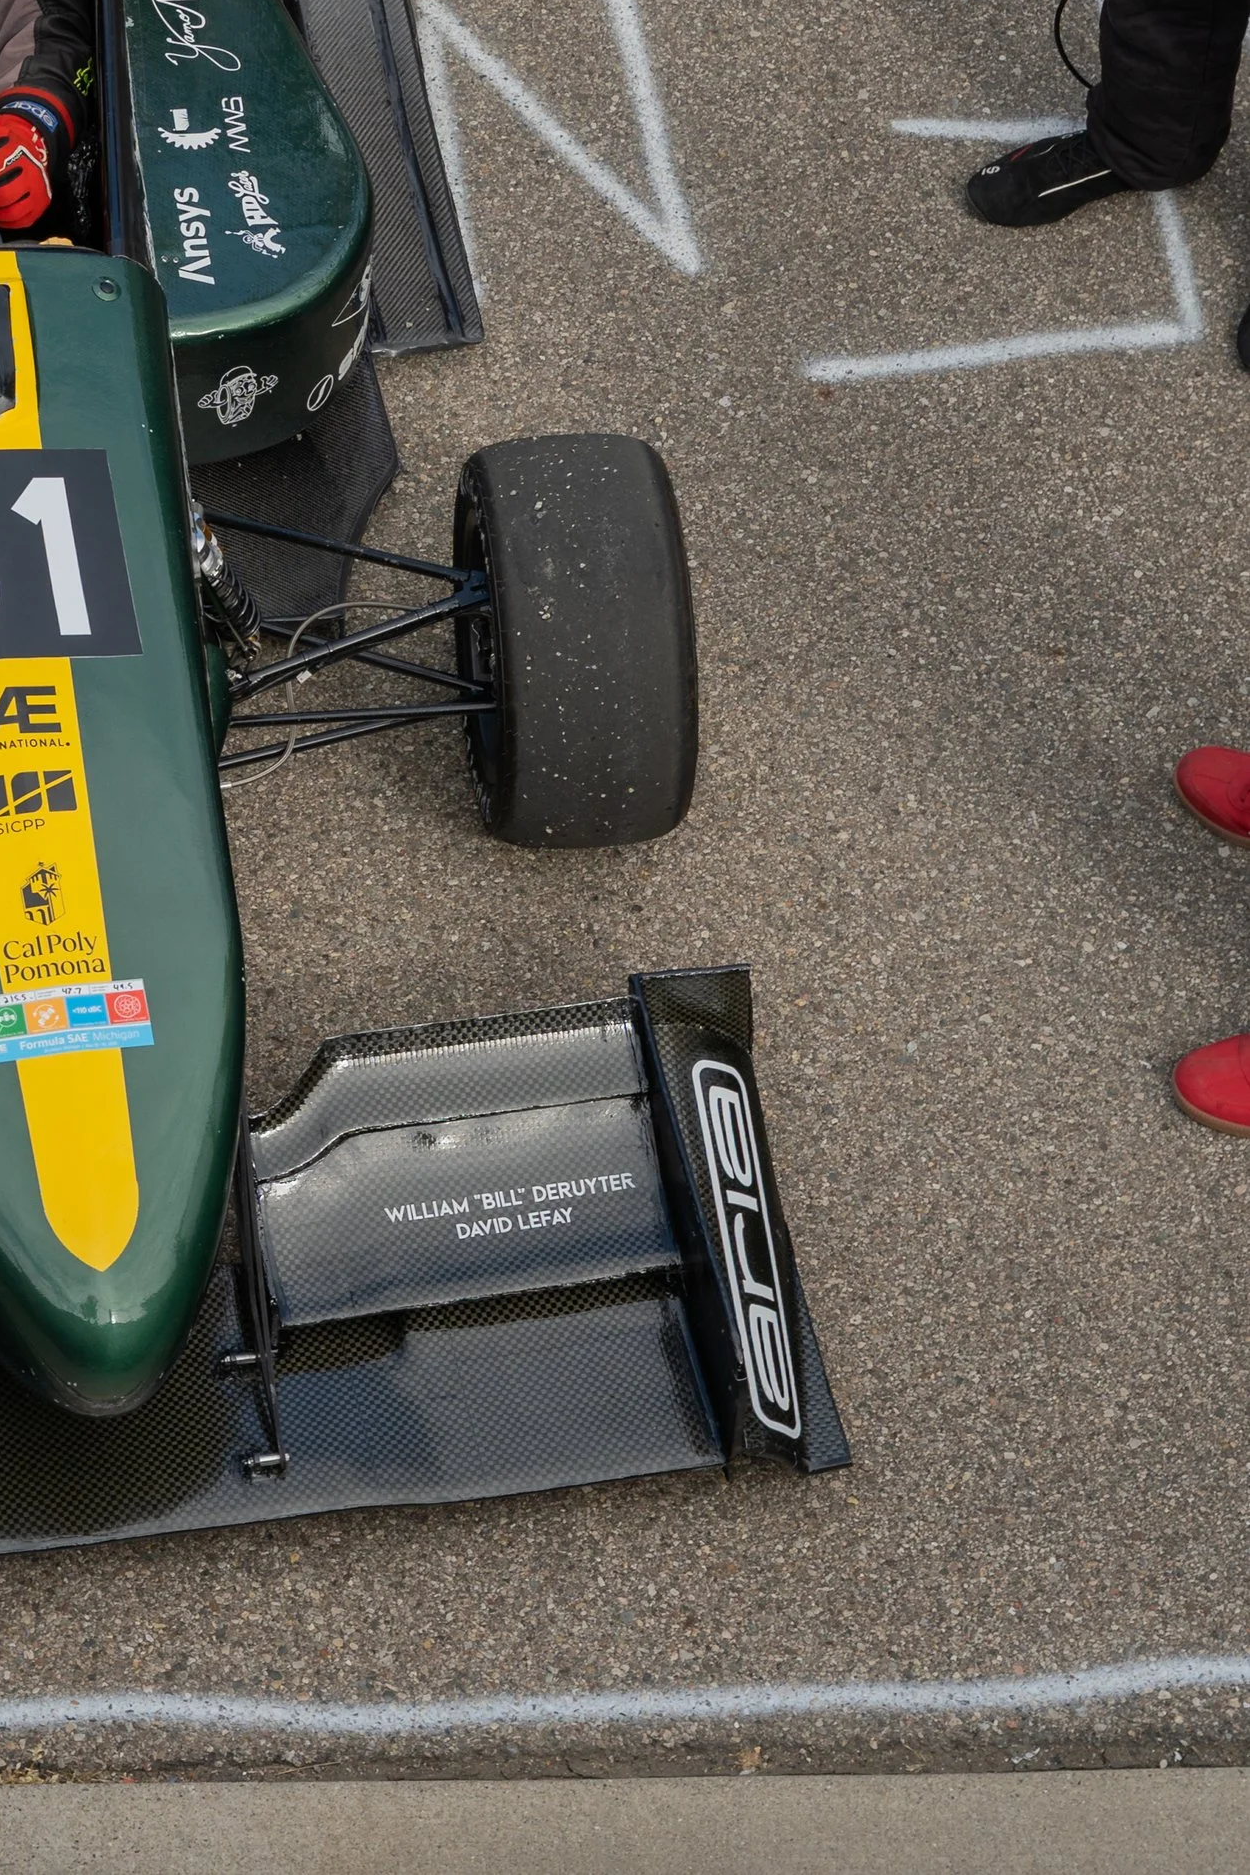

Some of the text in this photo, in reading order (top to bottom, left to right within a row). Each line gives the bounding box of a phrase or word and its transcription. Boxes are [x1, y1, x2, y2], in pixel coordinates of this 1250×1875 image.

[173, 186, 216, 285] Ansys
[3, 930, 98, 961] Cal Poly
[5, 957, 106, 983] Pomona
[19, 1037, 65, 1051] Formula
[67, 1032, 88, 1043] SAE
[92, 1029, 140, 1043] Michigan
[384, 1172, 636, 1223] WILLIAM "BILL" DERUYTER
[455, 1207, 573, 1240] DAVID LEFAY
